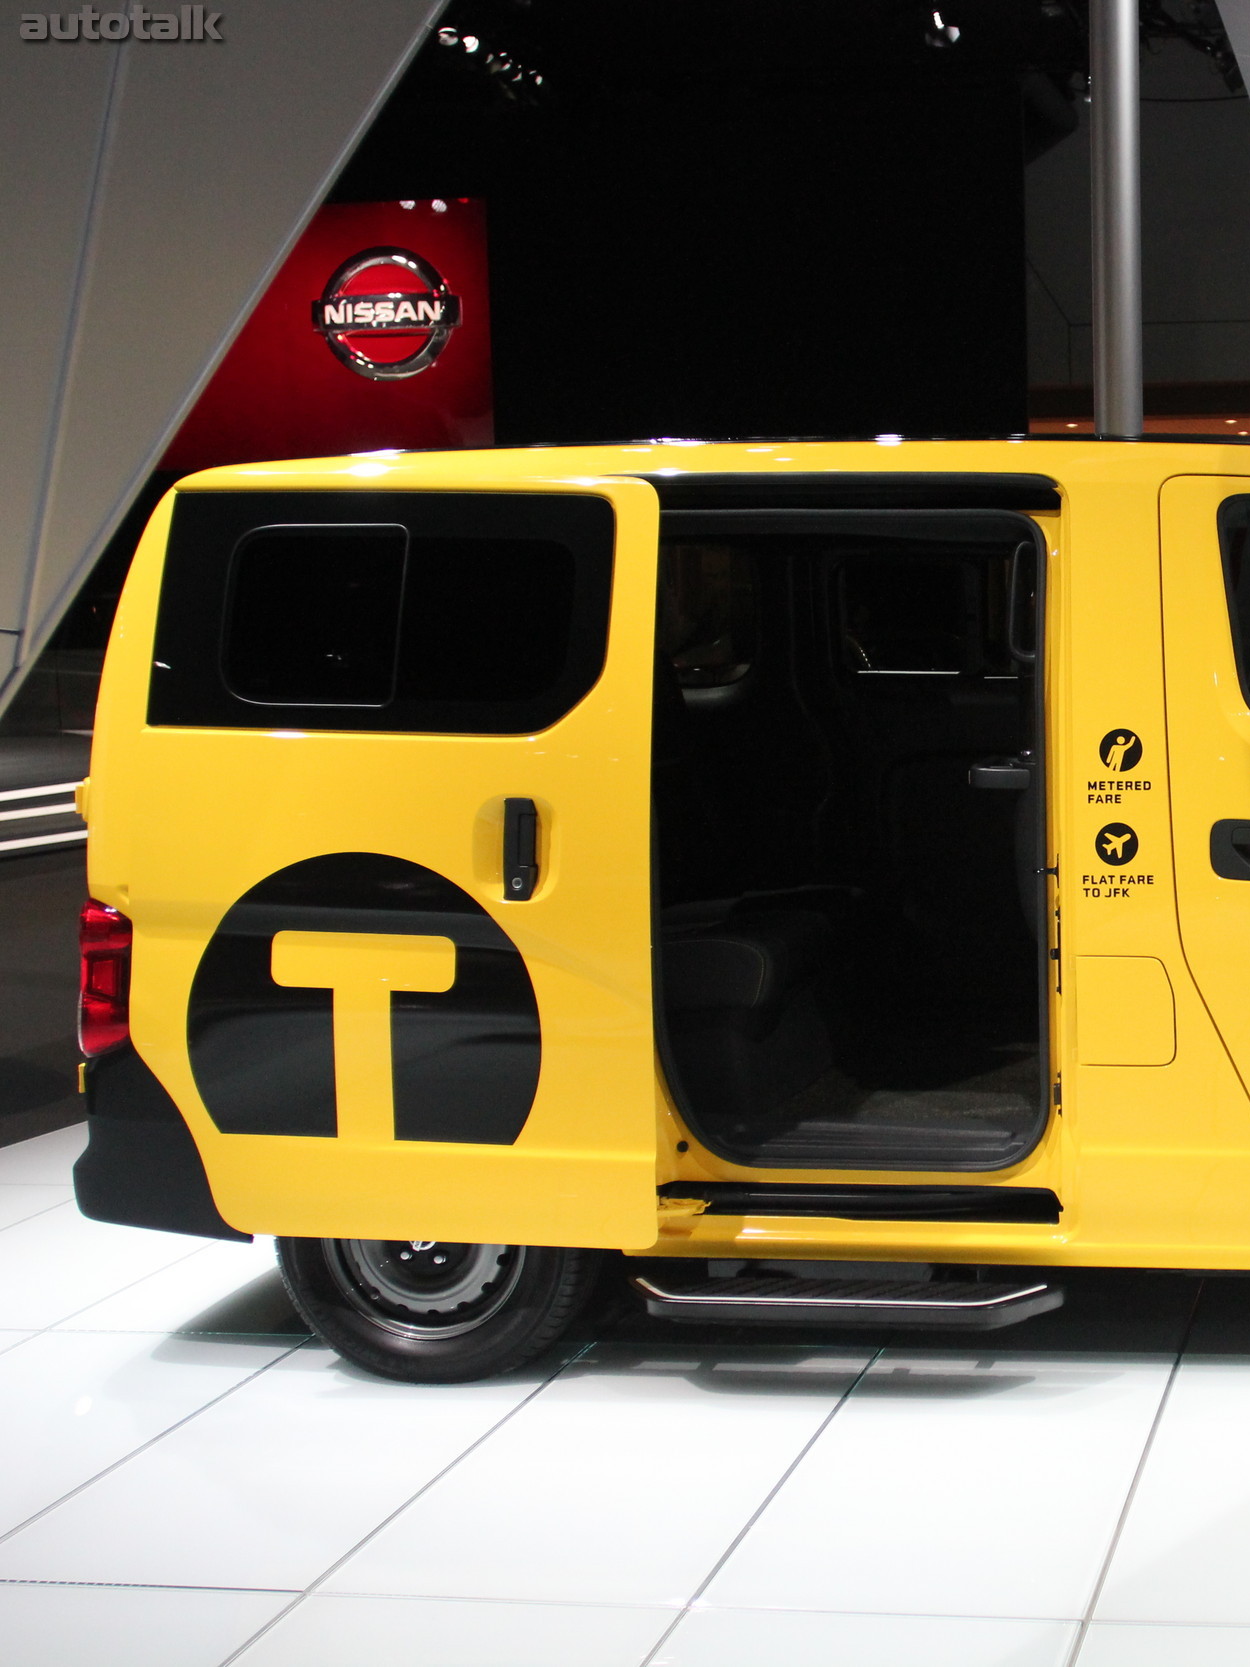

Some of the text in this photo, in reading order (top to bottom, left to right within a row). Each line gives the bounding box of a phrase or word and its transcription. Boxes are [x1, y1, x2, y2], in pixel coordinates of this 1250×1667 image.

[324, 301, 442, 325] NISSAN
[1088, 781, 1151, 790] METERED
[1088, 794, 1121, 803] FARE
[1083, 875, 1154, 884] FLAT FARE
[1083, 888, 1130, 897] TO JFK
